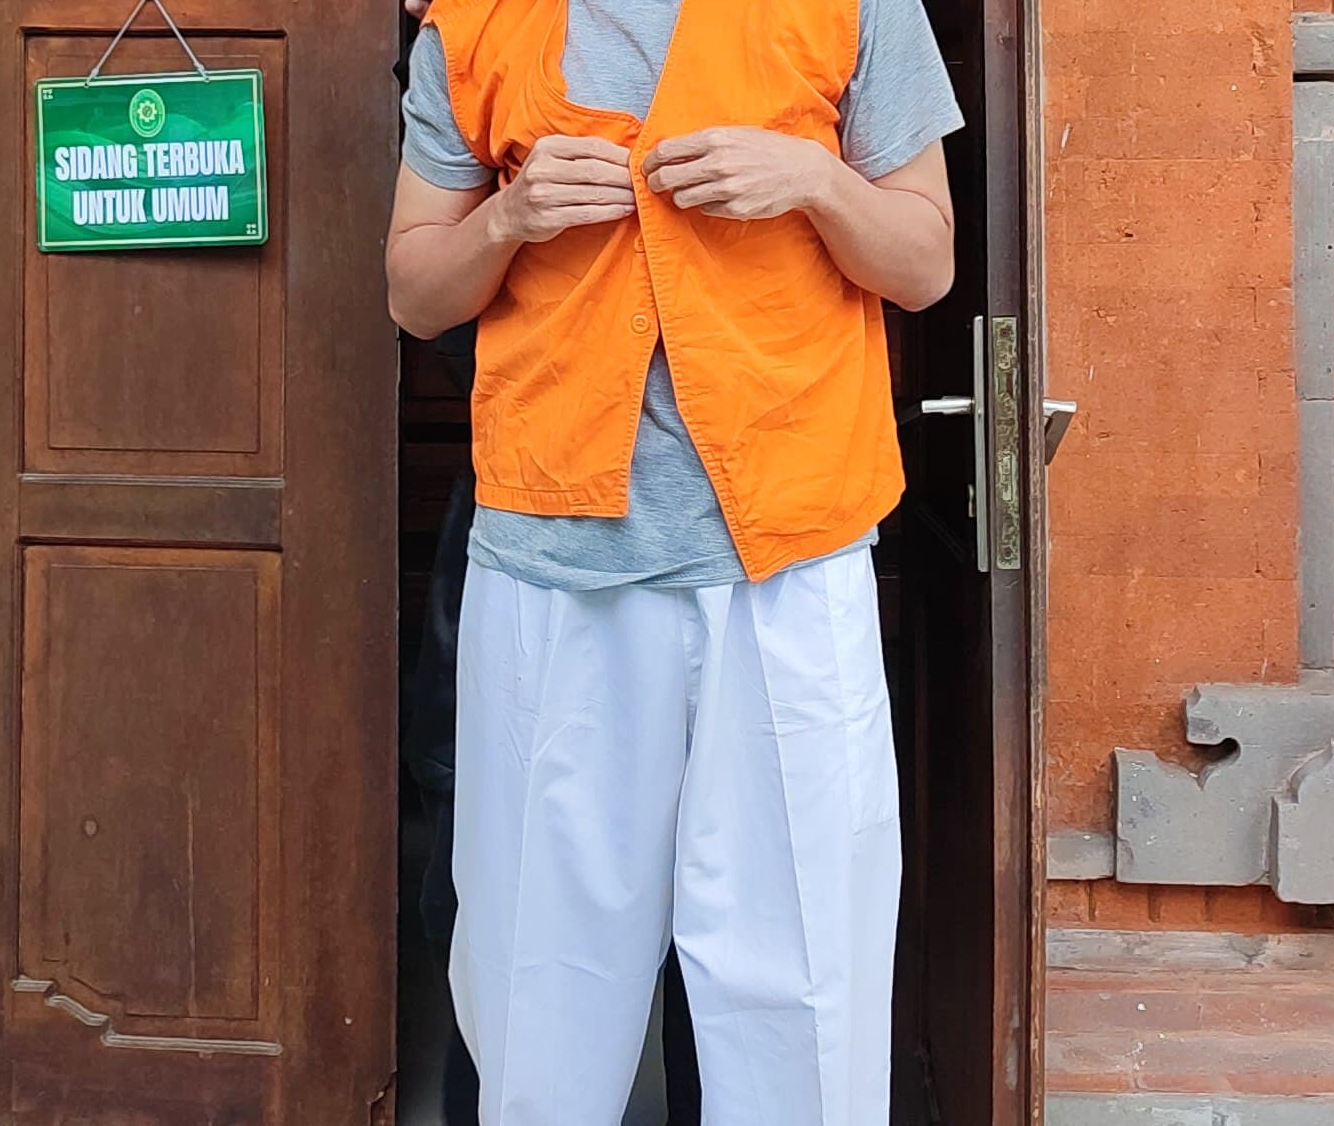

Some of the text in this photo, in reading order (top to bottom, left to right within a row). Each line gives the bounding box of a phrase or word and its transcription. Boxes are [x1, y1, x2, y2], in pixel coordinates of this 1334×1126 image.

[54, 139, 245, 181] SIDANG TERBUKA
[72, 185, 229, 225] UNTUK UMUM
